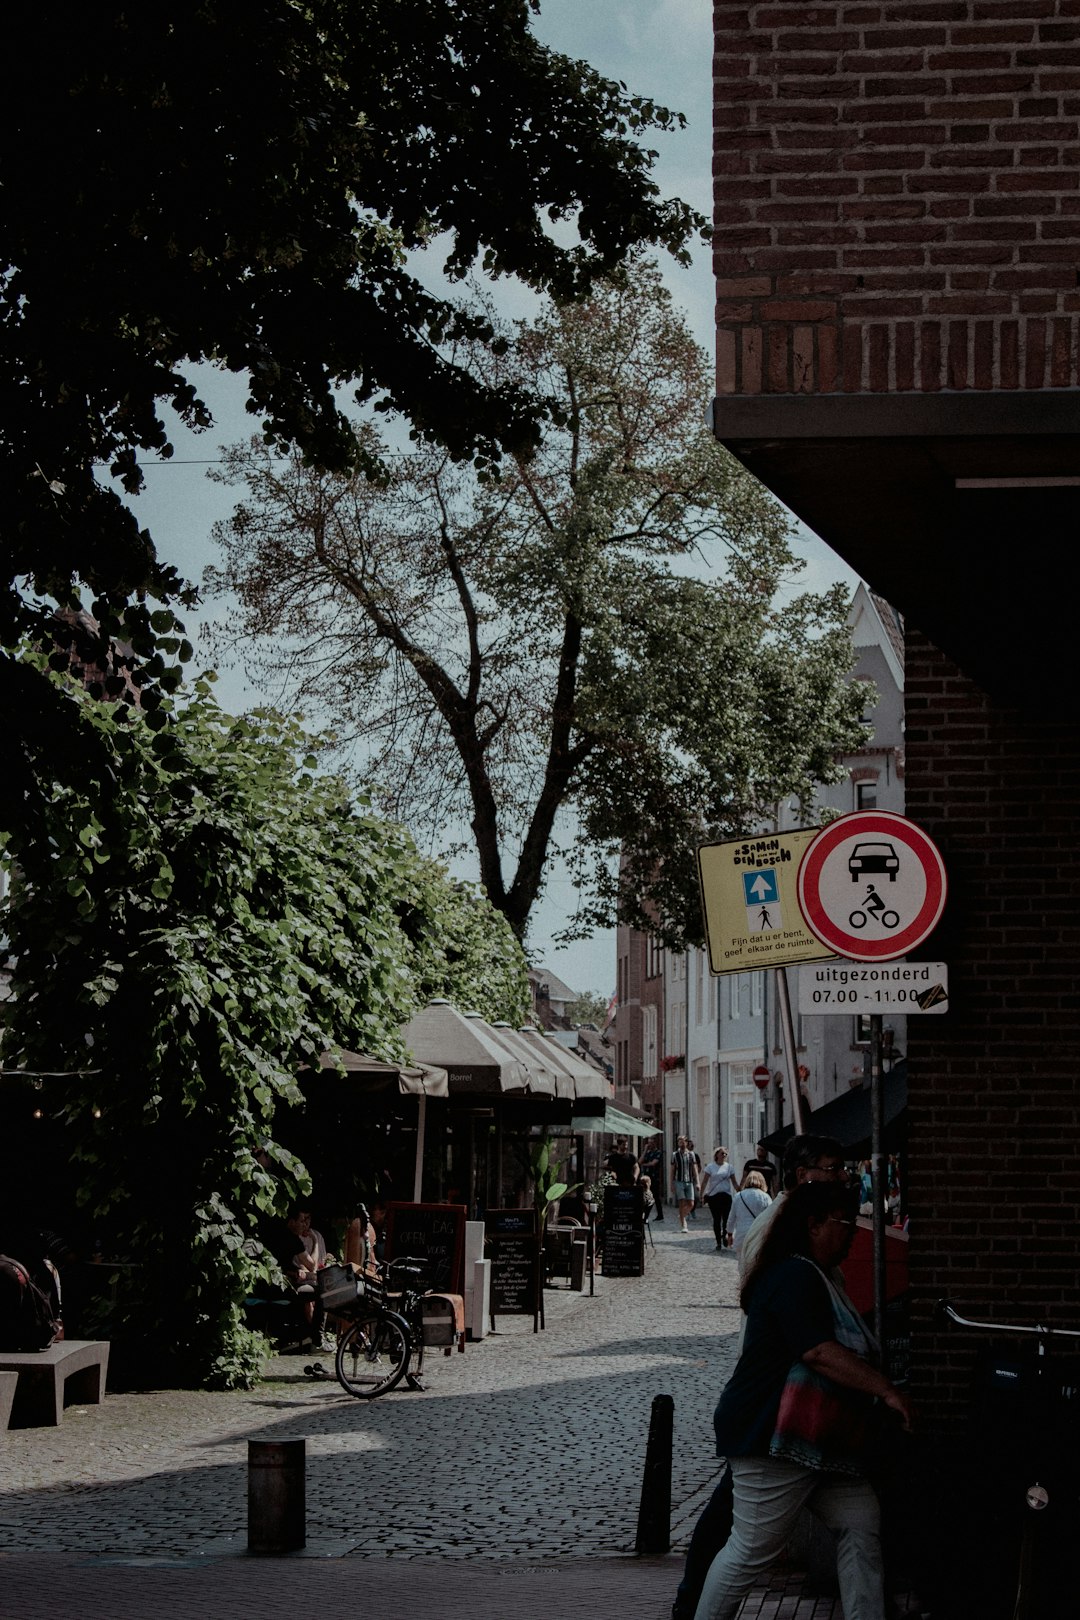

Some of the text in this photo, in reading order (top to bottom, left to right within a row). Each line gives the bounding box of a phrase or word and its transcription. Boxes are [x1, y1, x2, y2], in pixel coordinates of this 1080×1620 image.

[724, 938, 815, 958] geef elkaar de ruimte
[732, 938, 748, 948] Fijn
[749, 936, 763, 944] dat
[783, 930, 805, 938] bent,
[815, 966, 930, 985] uitgezonderd
[812, 989, 858, 1003] 07.00
[875, 989, 918, 1003] 11.00
[449, 1073, 473, 1082] Borrel
